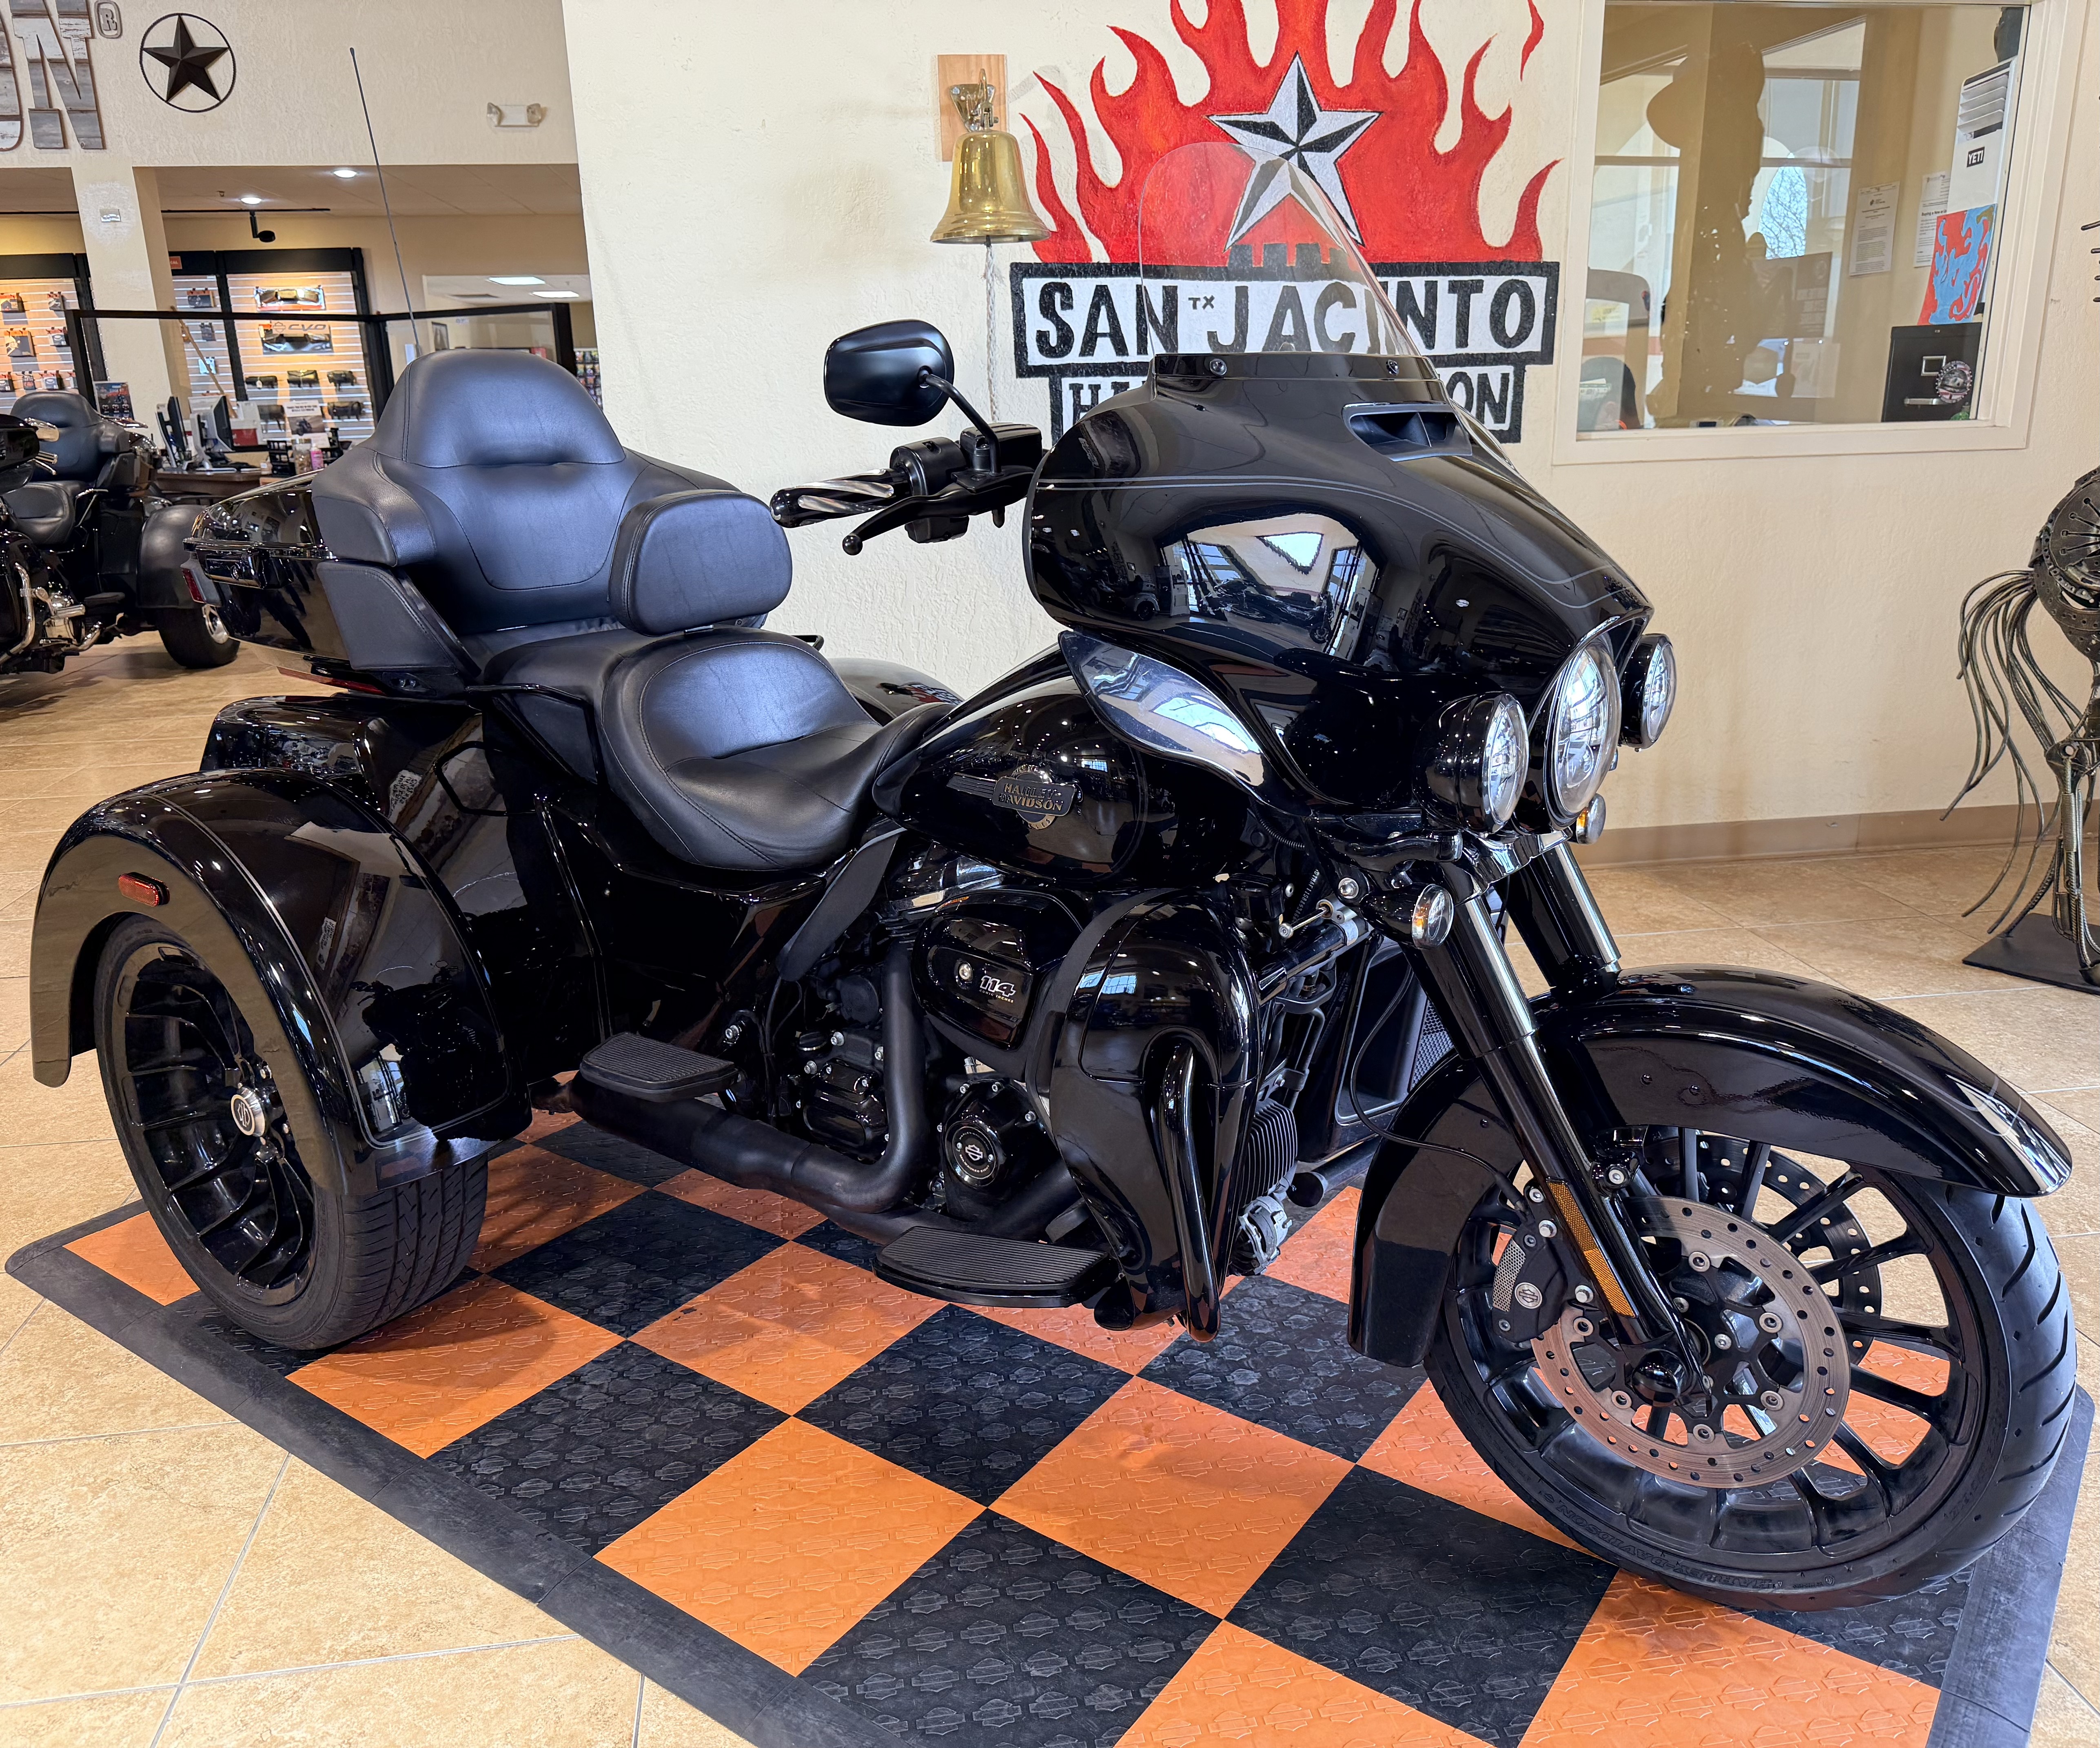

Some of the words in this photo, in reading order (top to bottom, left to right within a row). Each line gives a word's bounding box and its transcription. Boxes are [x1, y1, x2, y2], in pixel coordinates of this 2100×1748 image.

[1968, 150, 1984, 165] YETI
[1188, 294, 1215, 311] TX
[1036, 281, 1178, 359] SAN
[1207, 278, 1536, 354] JACINTO
[998, 793, 1064, 811] DAVIDSON
[980, 975, 1016, 997] 114
[996, 994, 1014, 1003] INCHES
